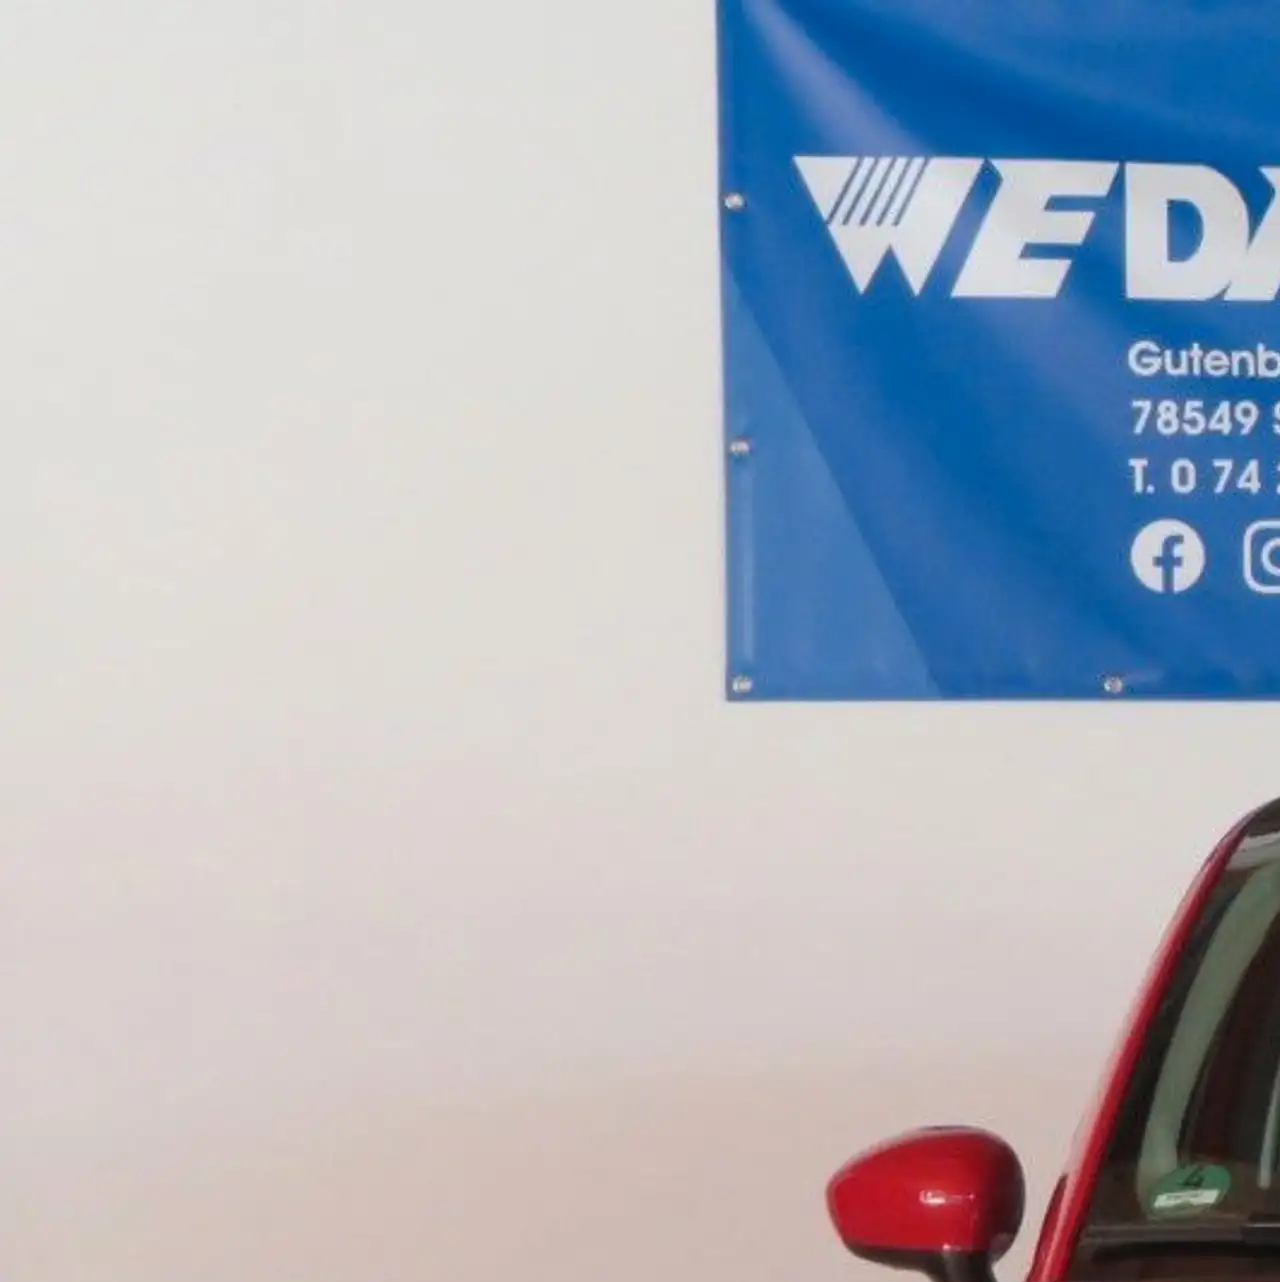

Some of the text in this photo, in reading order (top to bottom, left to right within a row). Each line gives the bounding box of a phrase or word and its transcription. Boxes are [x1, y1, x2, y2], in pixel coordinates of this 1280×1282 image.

[1131, 400, 1260, 436] 78549
[1128, 458, 1156, 494] T.
[1170, 457, 1197, 494] 0
[1212, 459, 1261, 495] 74
